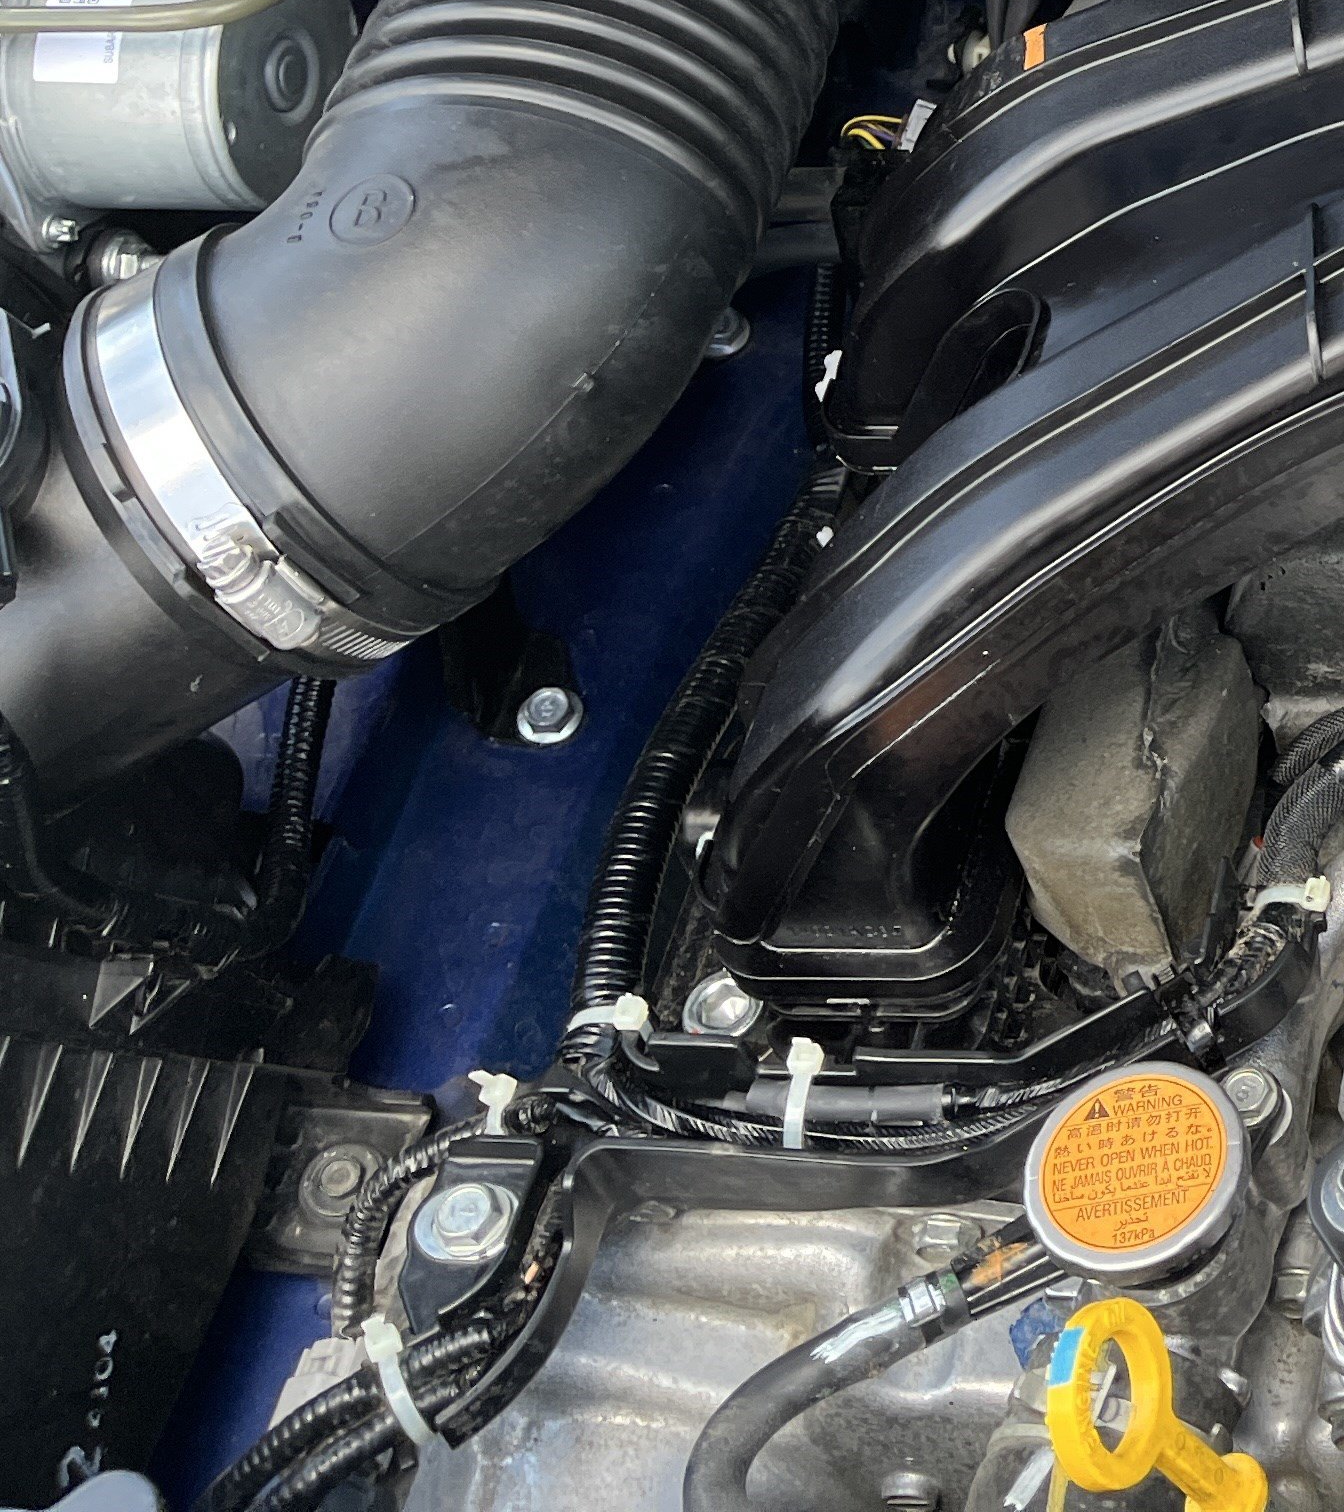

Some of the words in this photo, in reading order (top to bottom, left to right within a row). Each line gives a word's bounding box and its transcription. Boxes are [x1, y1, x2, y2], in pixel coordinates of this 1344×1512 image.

[1112, 1094, 1183, 1117] WARNING
[1114, 1083, 1160, 1103] 警告
[1052, 1156, 1096, 1176] NEVER
[1100, 1148, 1135, 1170] OPEN
[1139, 1140, 1180, 1160] WHEN
[1052, 1178, 1066, 1193] NE
[1070, 1172, 1112, 1190] JAMAIS
[1115, 1162, 1158, 1181] OUVRIR
[1162, 1157, 1170, 1173] À
[1075, 1188, 1191, 1223] AVERTISSEMENT
[1111, 1227, 1156, 1246] 137kPa
